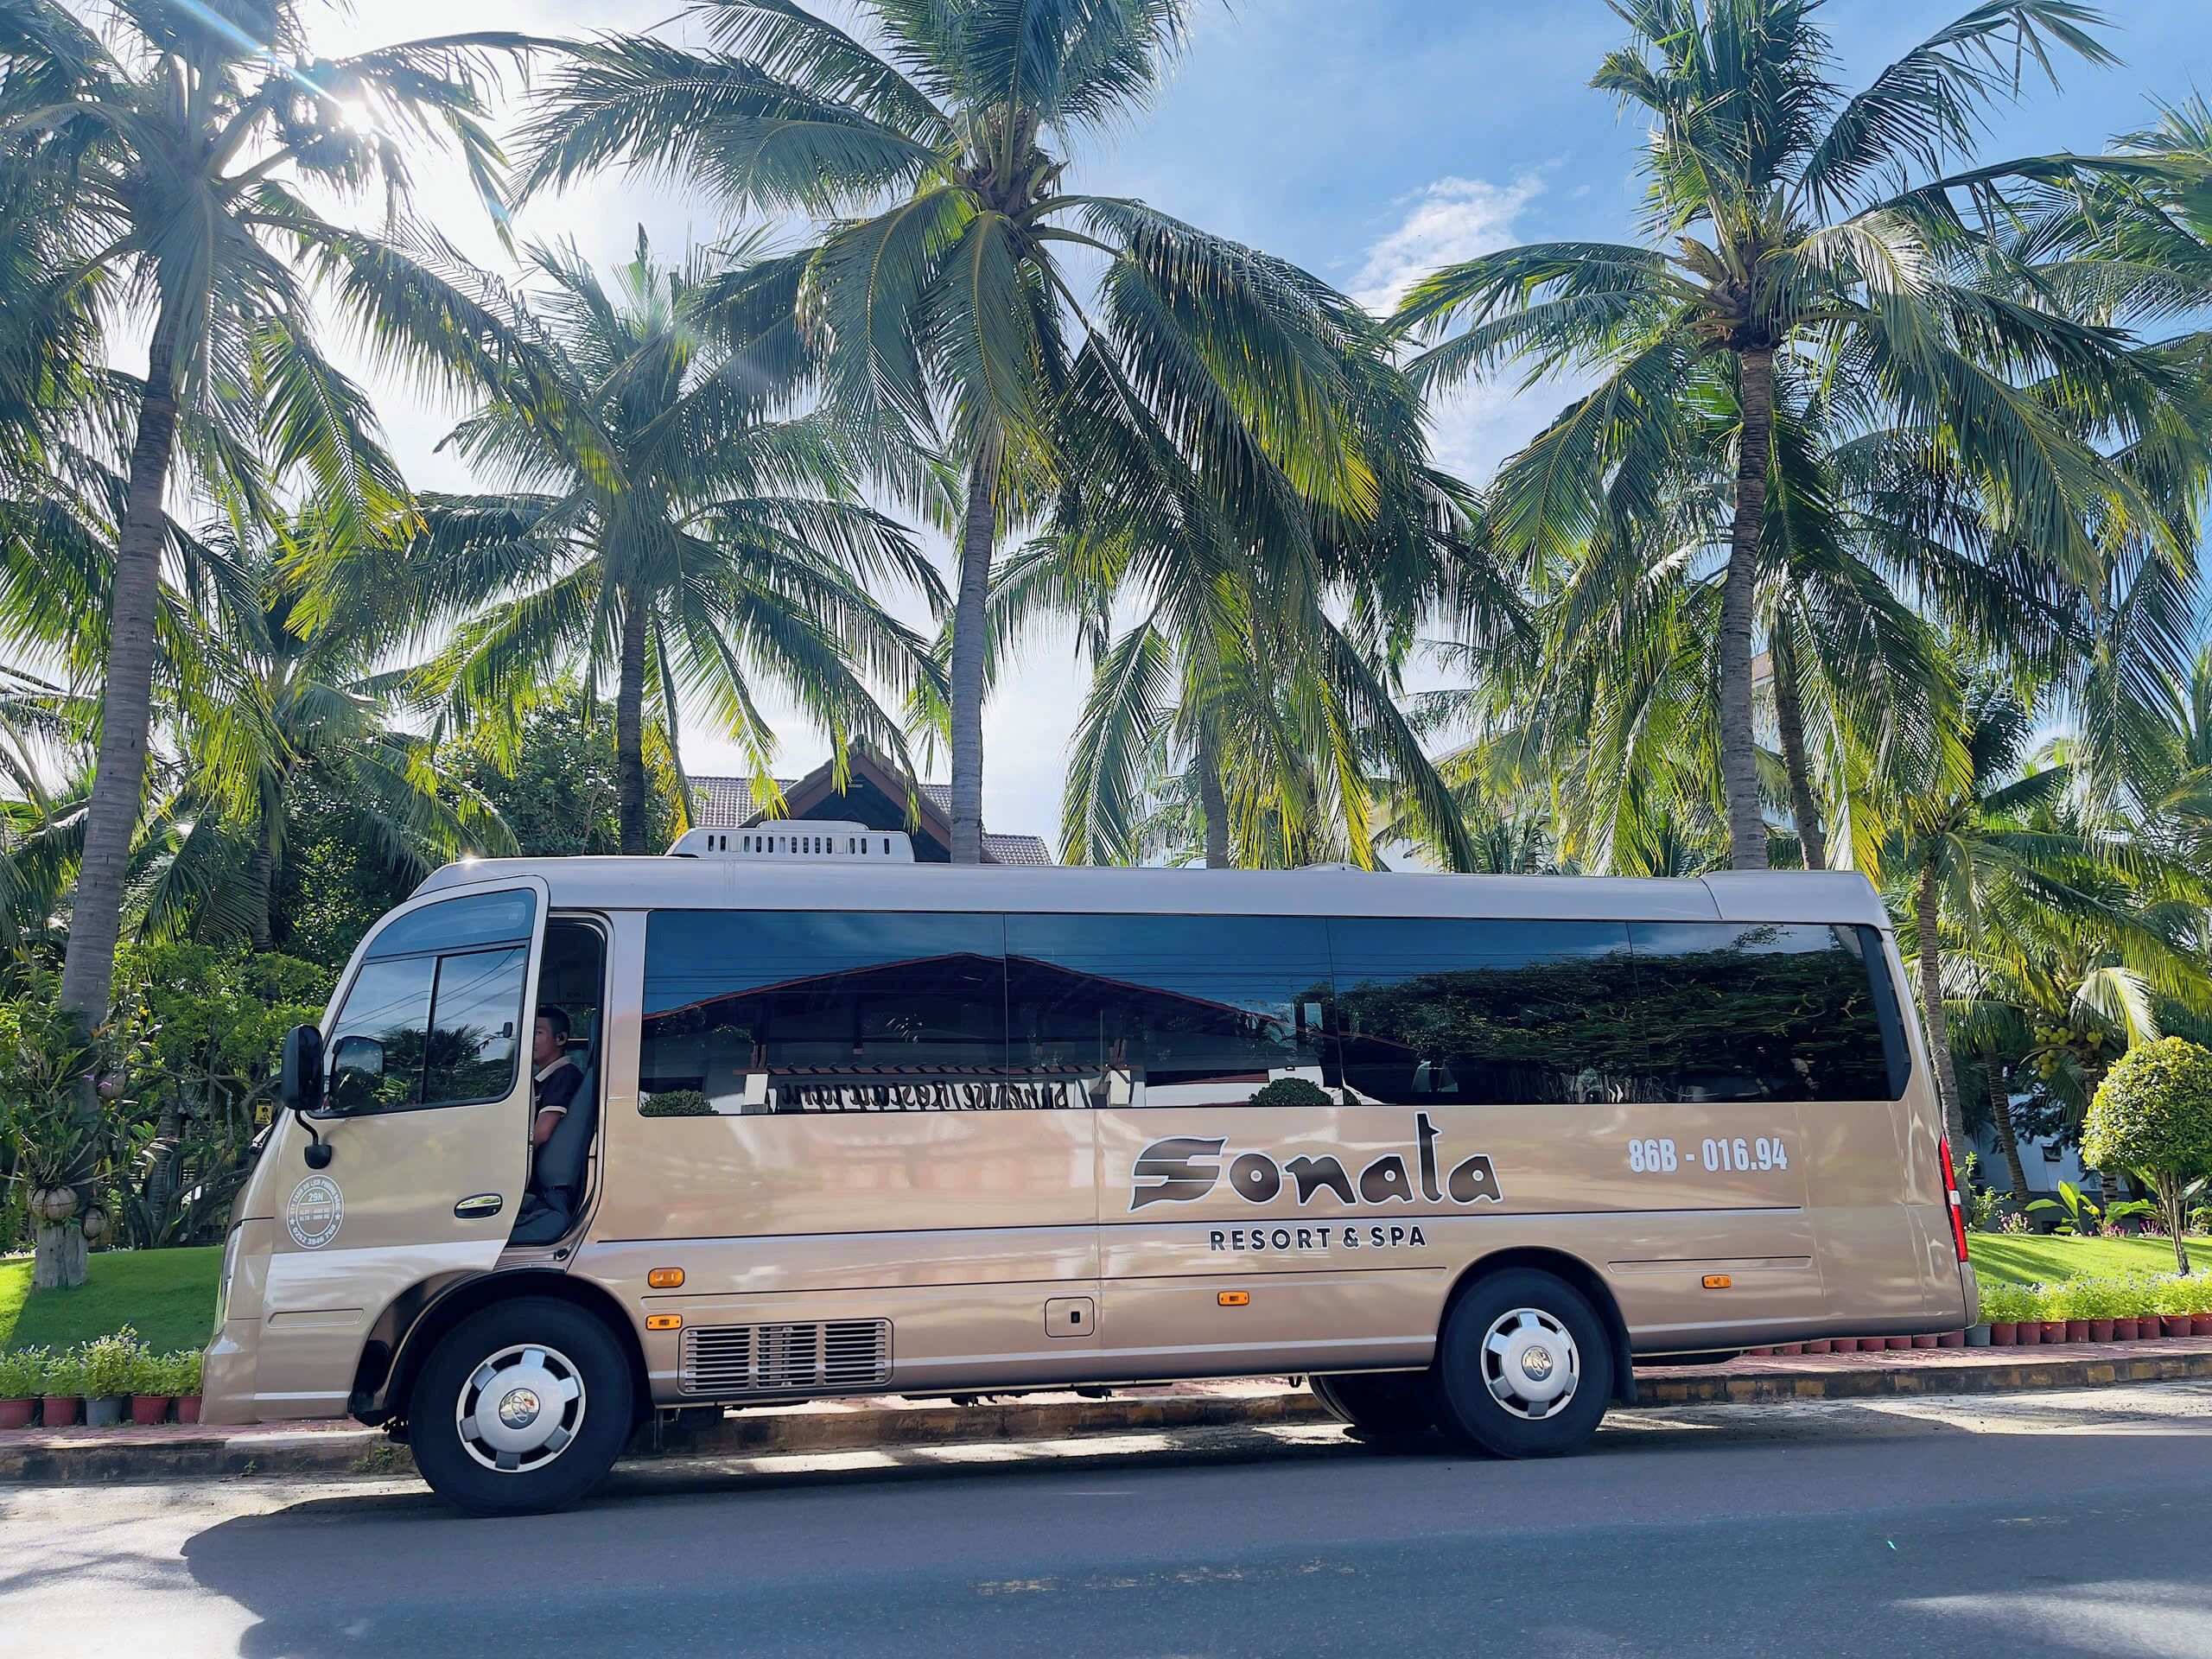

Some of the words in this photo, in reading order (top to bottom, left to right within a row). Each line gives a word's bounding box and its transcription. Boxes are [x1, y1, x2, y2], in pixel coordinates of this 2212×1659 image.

[1127, 1110, 1504, 1213] Sonata
[1628, 1139, 1678, 1173] 86B
[1701, 1137, 1788, 1172] 016.94
[308, 1192, 324, 1202] 29N
[292, 1227, 307, 1243] 0252
[1210, 1226, 1331, 1251] RESORT
[1343, 1227, 1359, 1249] &
[1370, 1225, 1427, 1248] SPA
